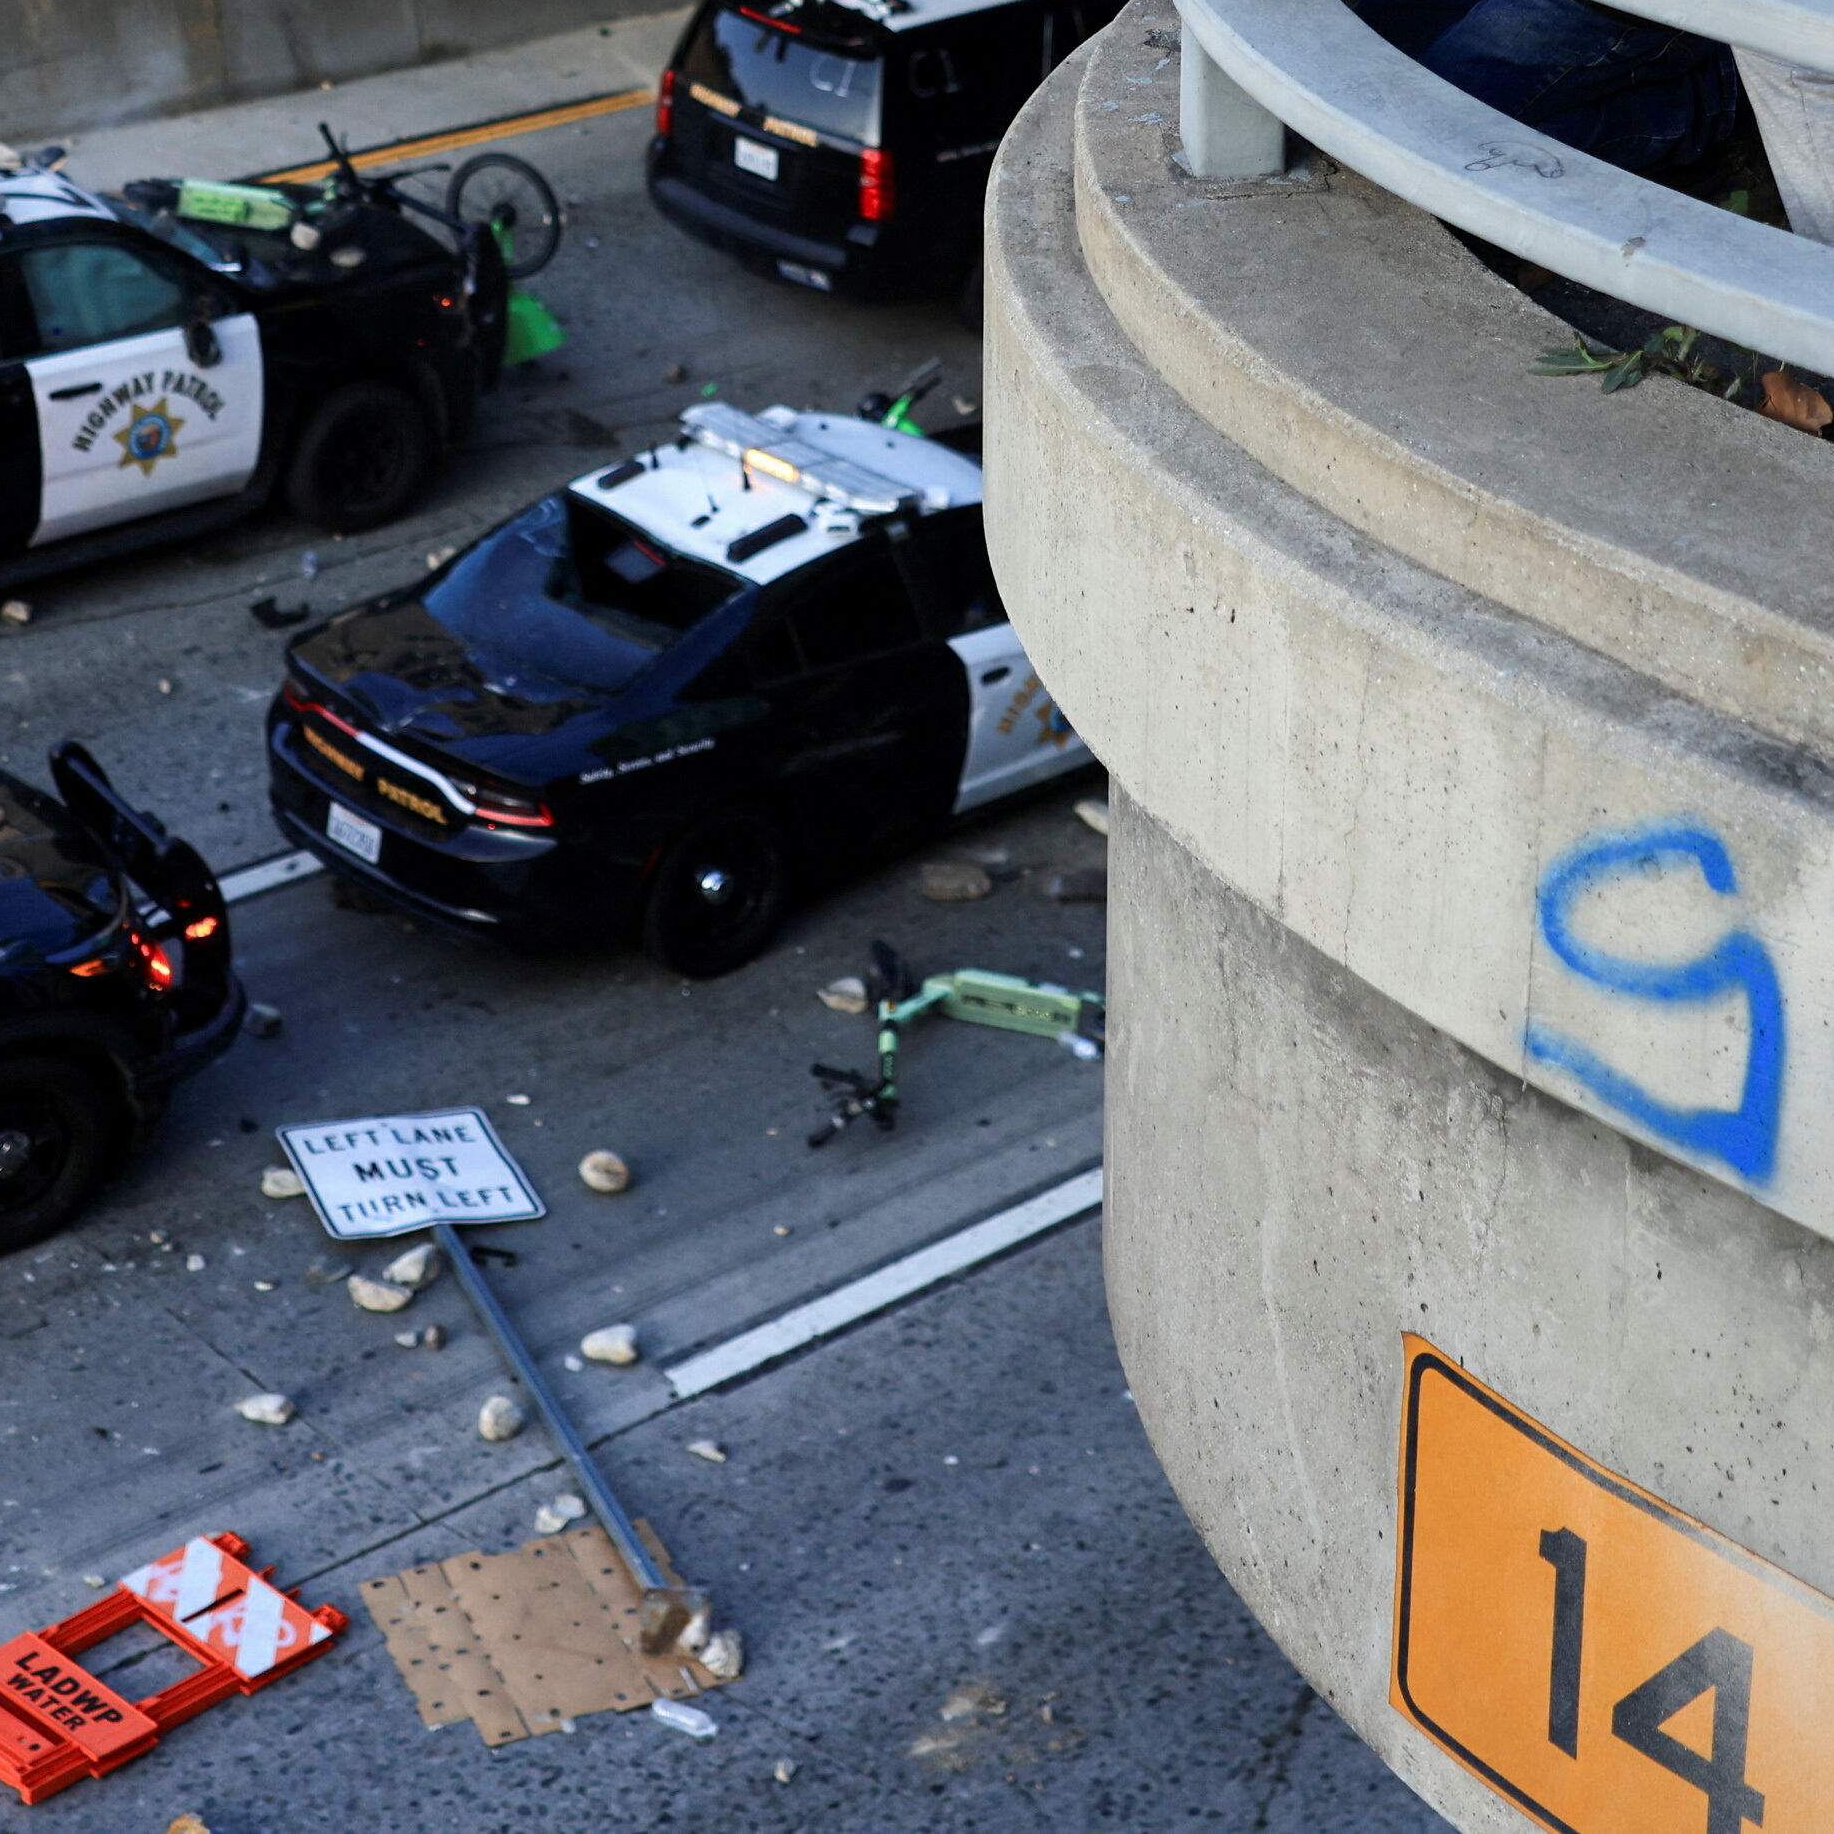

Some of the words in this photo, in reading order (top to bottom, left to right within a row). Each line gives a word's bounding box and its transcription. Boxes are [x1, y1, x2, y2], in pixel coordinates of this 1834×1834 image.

[72, 371, 155, 452] HIGHWAY
[161, 370, 226, 421] PATROL
[377, 777, 448, 826] PATROL
[303, 1129, 380, 1155] LEFT
[391, 1125, 476, 1146] LANE
[353, 1157, 460, 1184] MUST
[337, 1191, 427, 1223] TURN
[436, 1186, 514, 1208] LEFT
[6, 1673, 87, 1732] WATER
[15, 1651, 124, 1726] LADWP
[1539, 1525, 1766, 1834] 14
